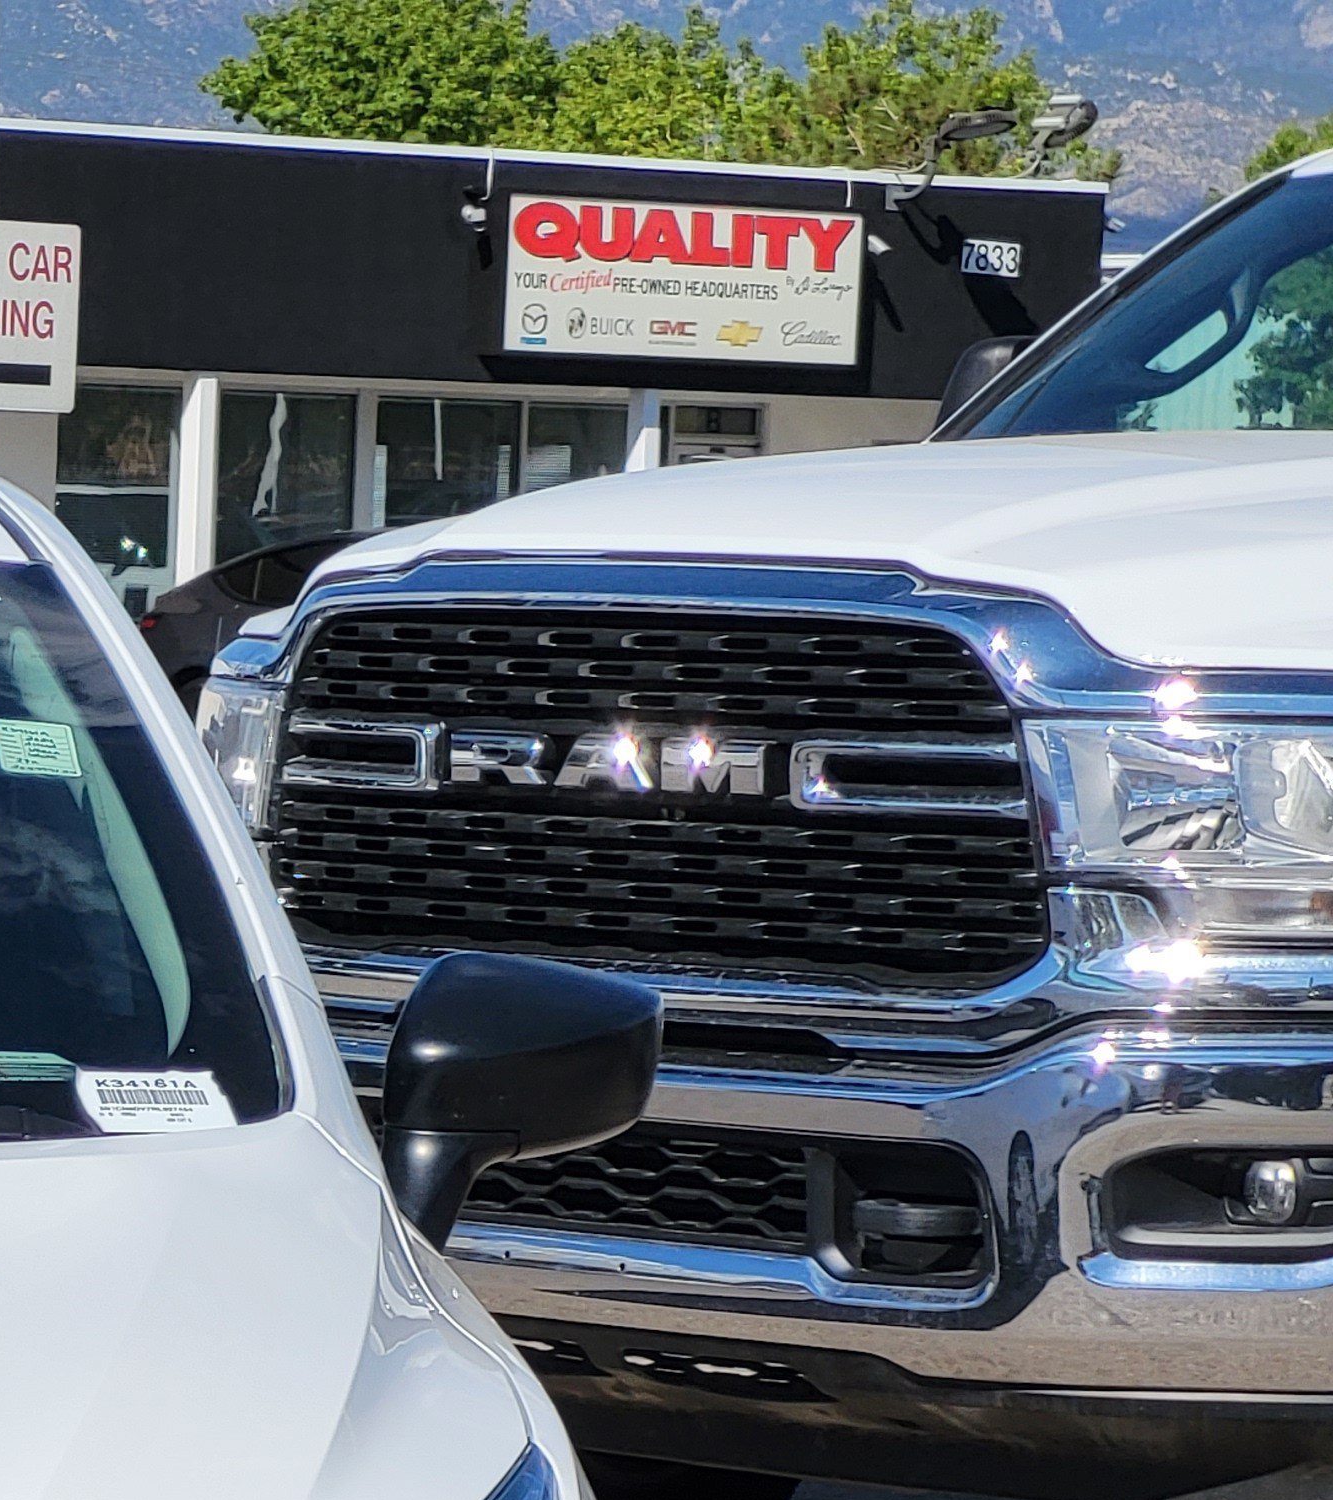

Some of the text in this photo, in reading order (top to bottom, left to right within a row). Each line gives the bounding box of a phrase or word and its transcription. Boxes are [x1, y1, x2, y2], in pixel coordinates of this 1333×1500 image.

[513, 201, 855, 272] QUALITY
[8, 242, 73, 283] CAR
[963, 243, 1018, 273] 7833
[514, 272, 547, 289] YOUR
[549, 268, 613, 294] Certified
[613, 277, 681, 295] PRE-OWNED
[684, 280, 778, 300] HEADQUARTERS
[590, 317, 842, 346] BUICK GMC Cadillac
[449, 727, 767, 796] RAM
